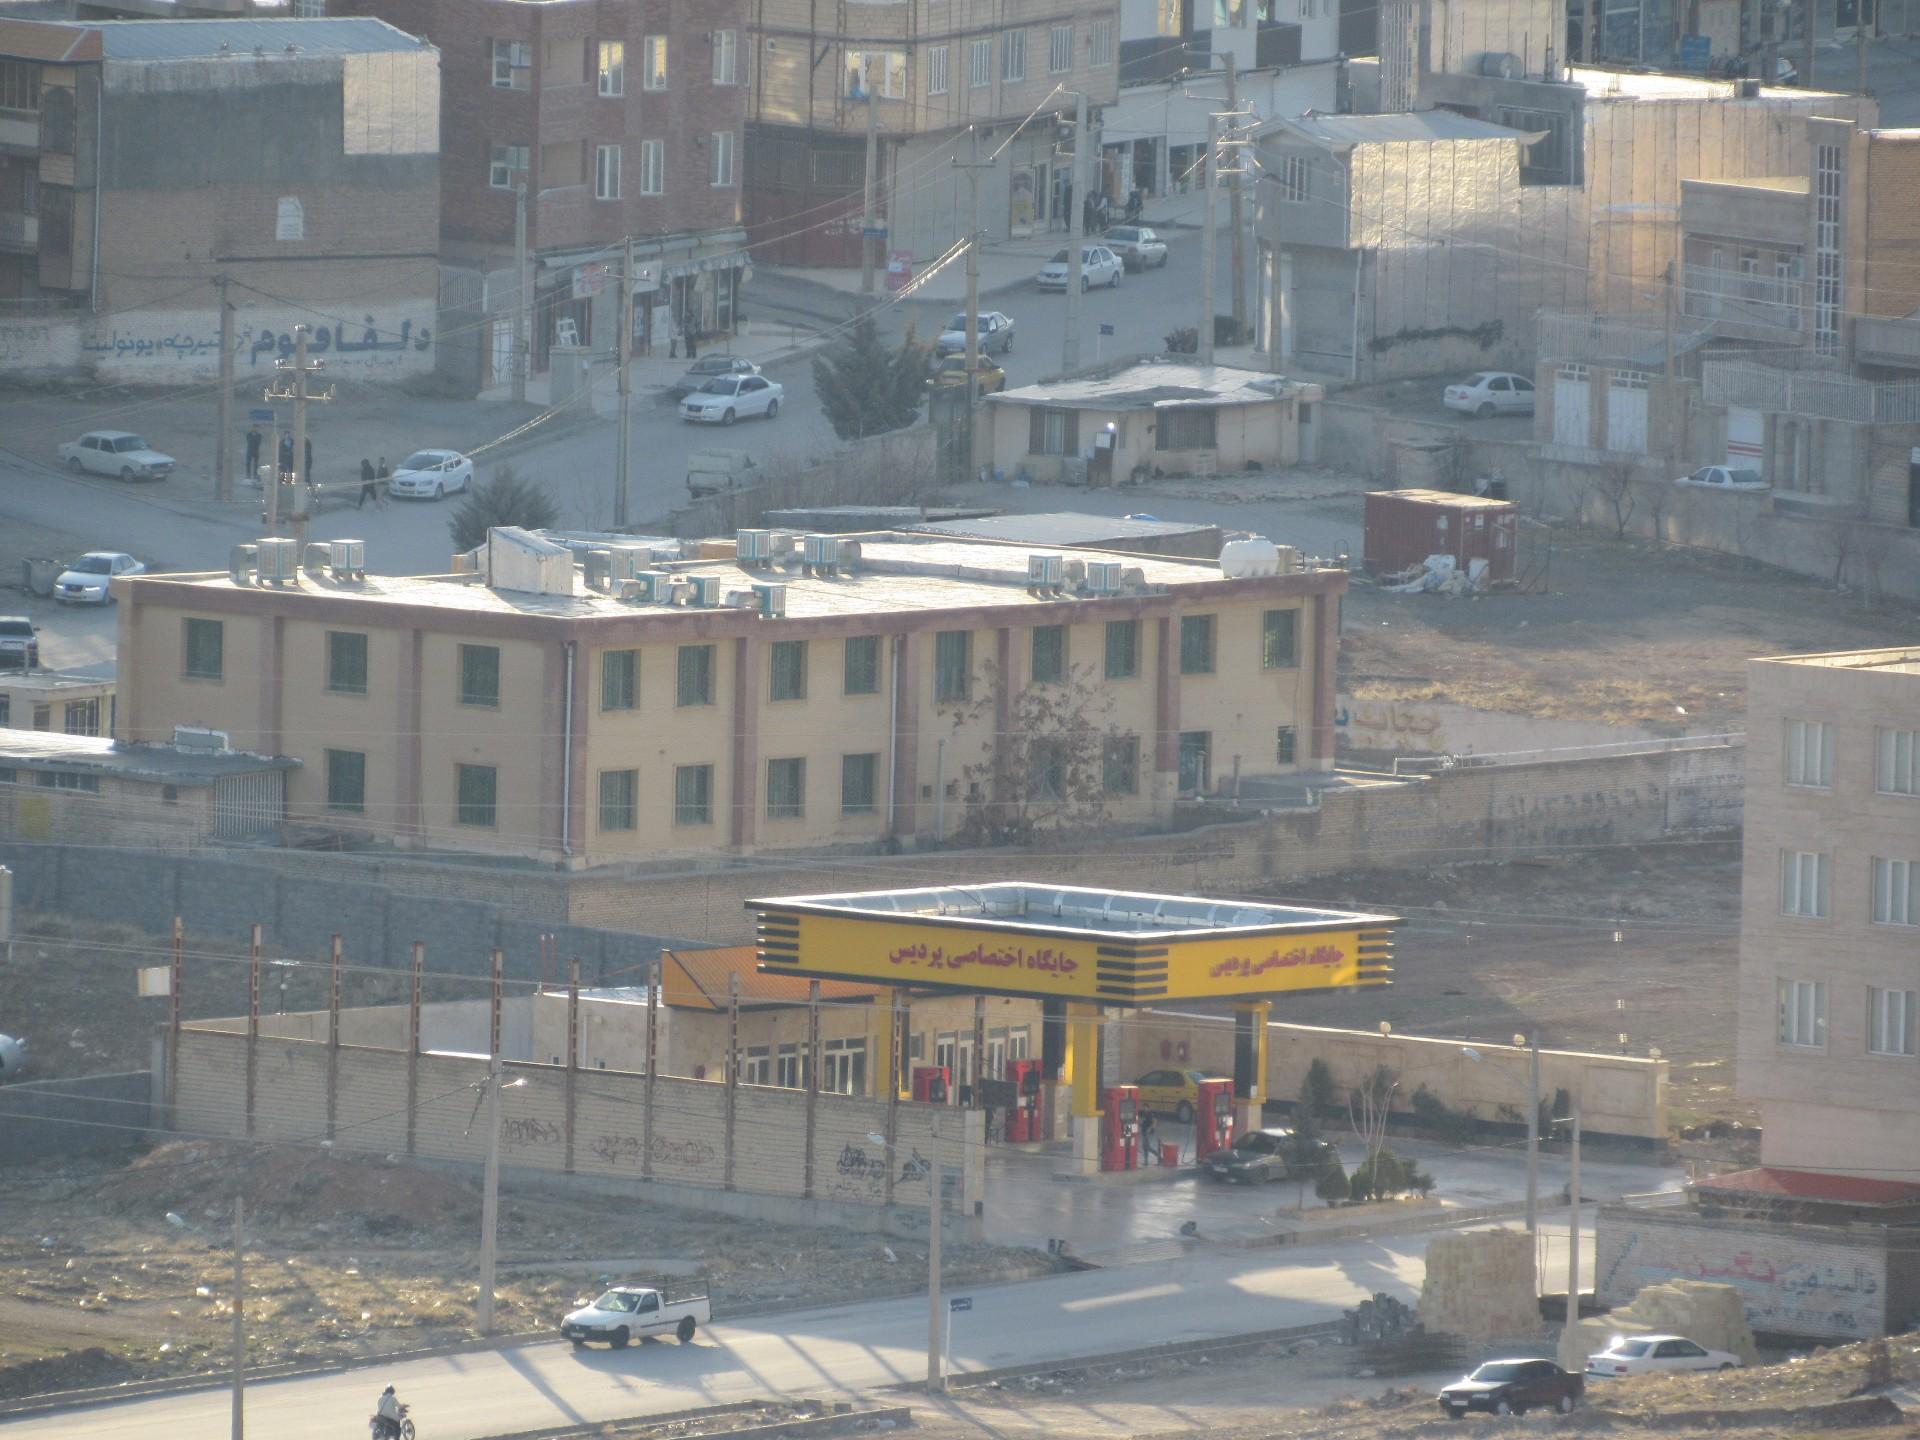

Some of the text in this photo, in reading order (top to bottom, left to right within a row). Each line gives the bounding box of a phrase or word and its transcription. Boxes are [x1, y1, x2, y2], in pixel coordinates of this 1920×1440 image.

[889, 943, 1079, 979] جایگاه اختصاصی پردیس
[1209, 945, 1345, 978] جایگاه اختصاصی پردیس
